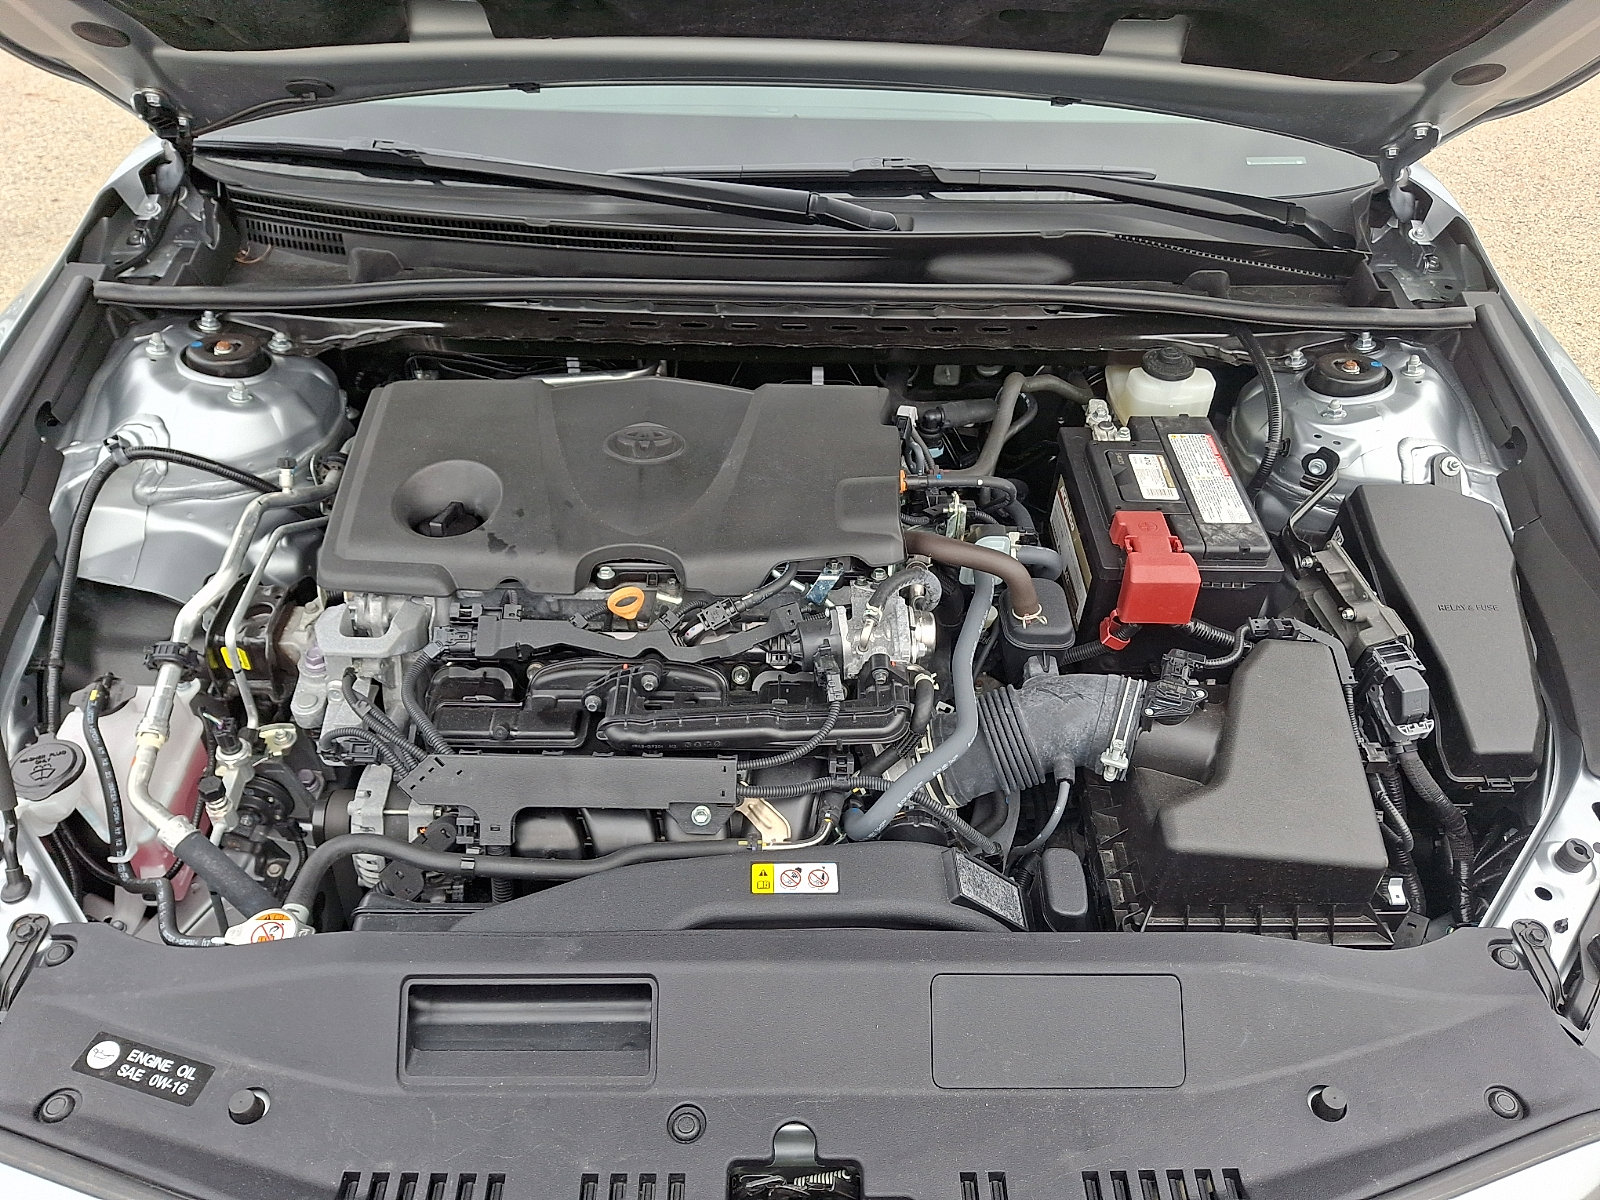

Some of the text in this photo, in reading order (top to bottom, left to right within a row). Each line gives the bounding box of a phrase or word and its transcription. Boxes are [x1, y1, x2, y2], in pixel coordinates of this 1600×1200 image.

[1437, 604, 1466, 612] RELAY
[1475, 604, 1500, 612] FUSE
[116, 1064, 189, 1096] SAE 0W-16
[126, 1049, 196, 1081] ENGINE OIL
